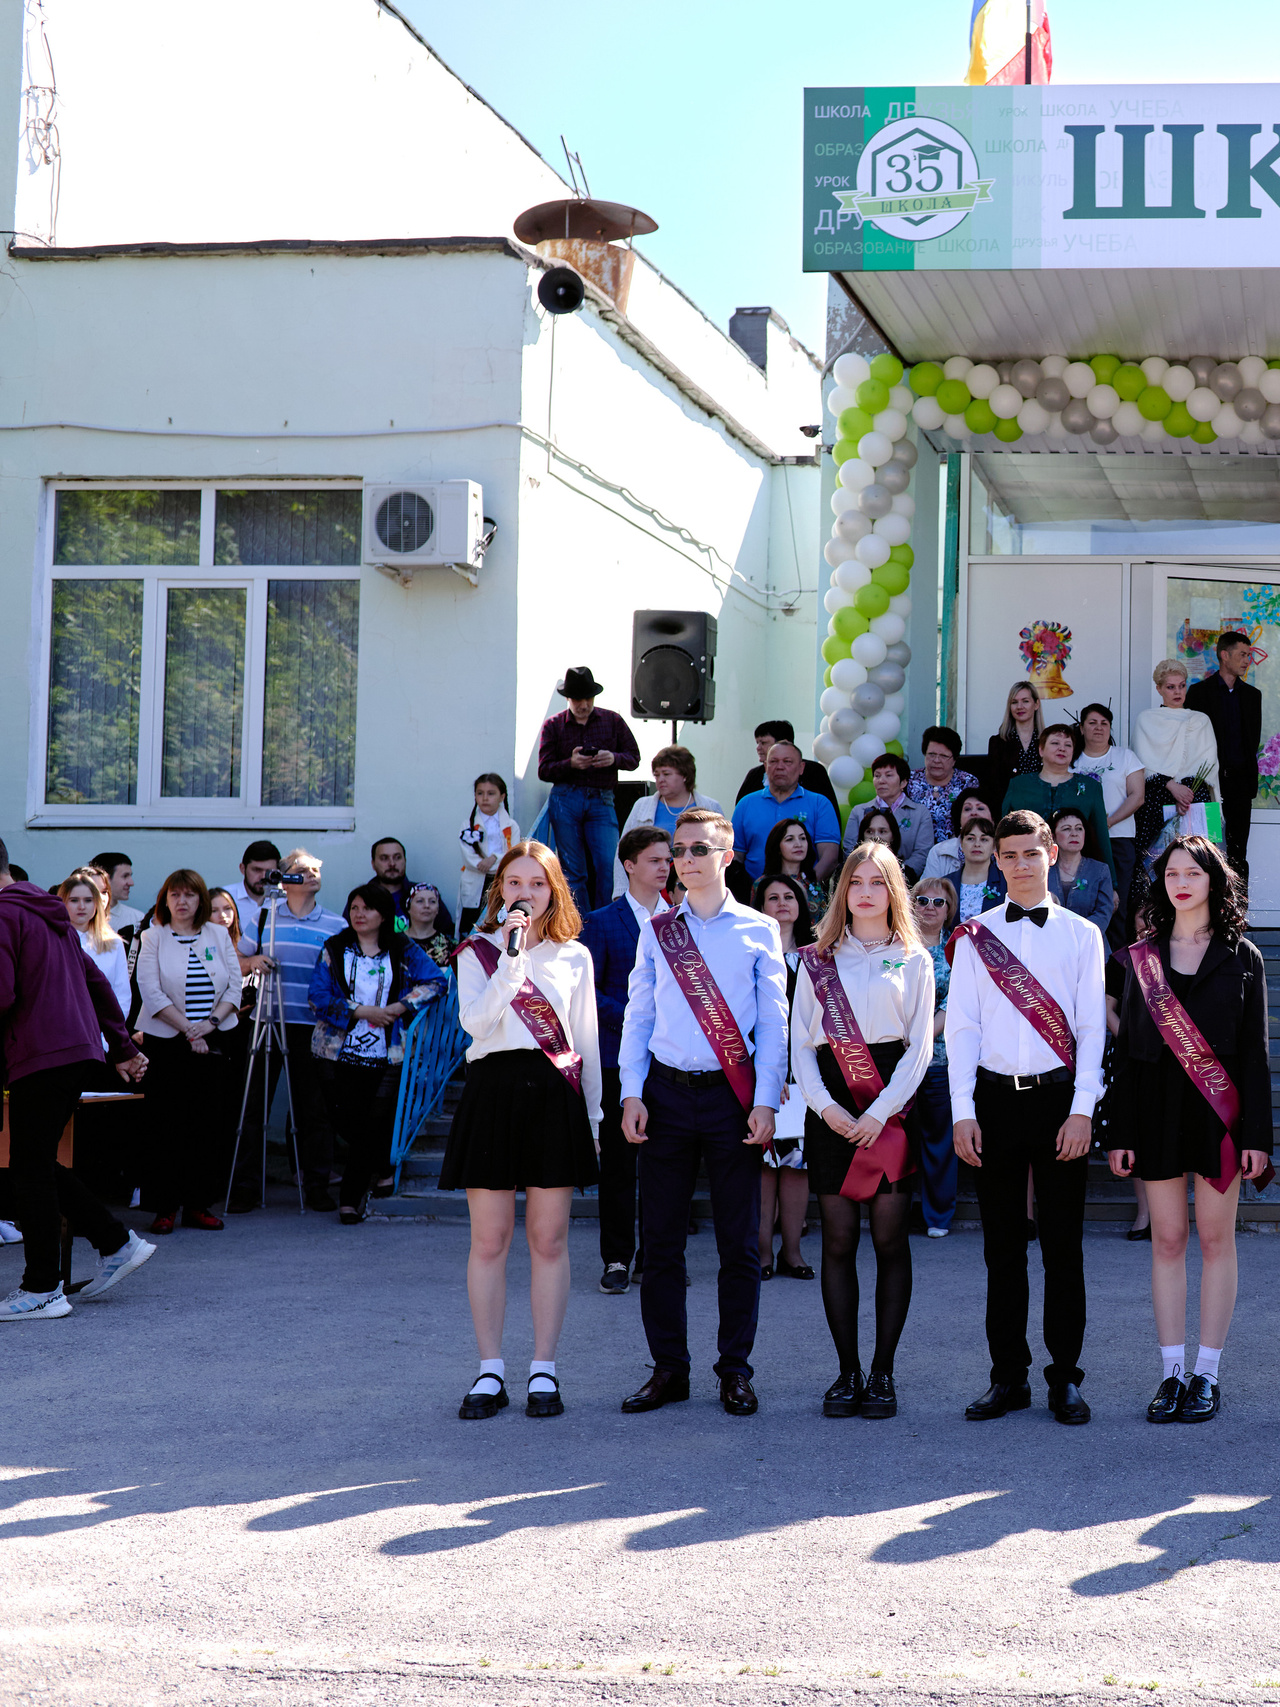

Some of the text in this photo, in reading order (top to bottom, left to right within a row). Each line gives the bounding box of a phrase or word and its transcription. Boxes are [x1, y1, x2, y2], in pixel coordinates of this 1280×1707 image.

[814, 105, 871, 118] ШКОЛА
[999, 106, 1028, 118] УРОК
[1040, 103, 1097, 117] ШКОЛА
[1109, 99, 1185, 119] УЧЕБА
[985, 140, 1047, 153] ШКОЛА
[814, 176, 850, 187] УРОК
[885, 154, 943, 193] 35
[881, 196, 952, 213] ШКОЛА
[814, 233, 1138, 255] ОБРАЗОВАНИЕ ШКОЛА ДРУЗЬЯ УЧЕБА
[678, 946, 746, 1065] Выпускник 2022
[1002, 964, 1064, 1036] Выпускник
[1153, 983, 1229, 1095] Выпускница 2022
[839, 1043, 874, 1081] 2022
